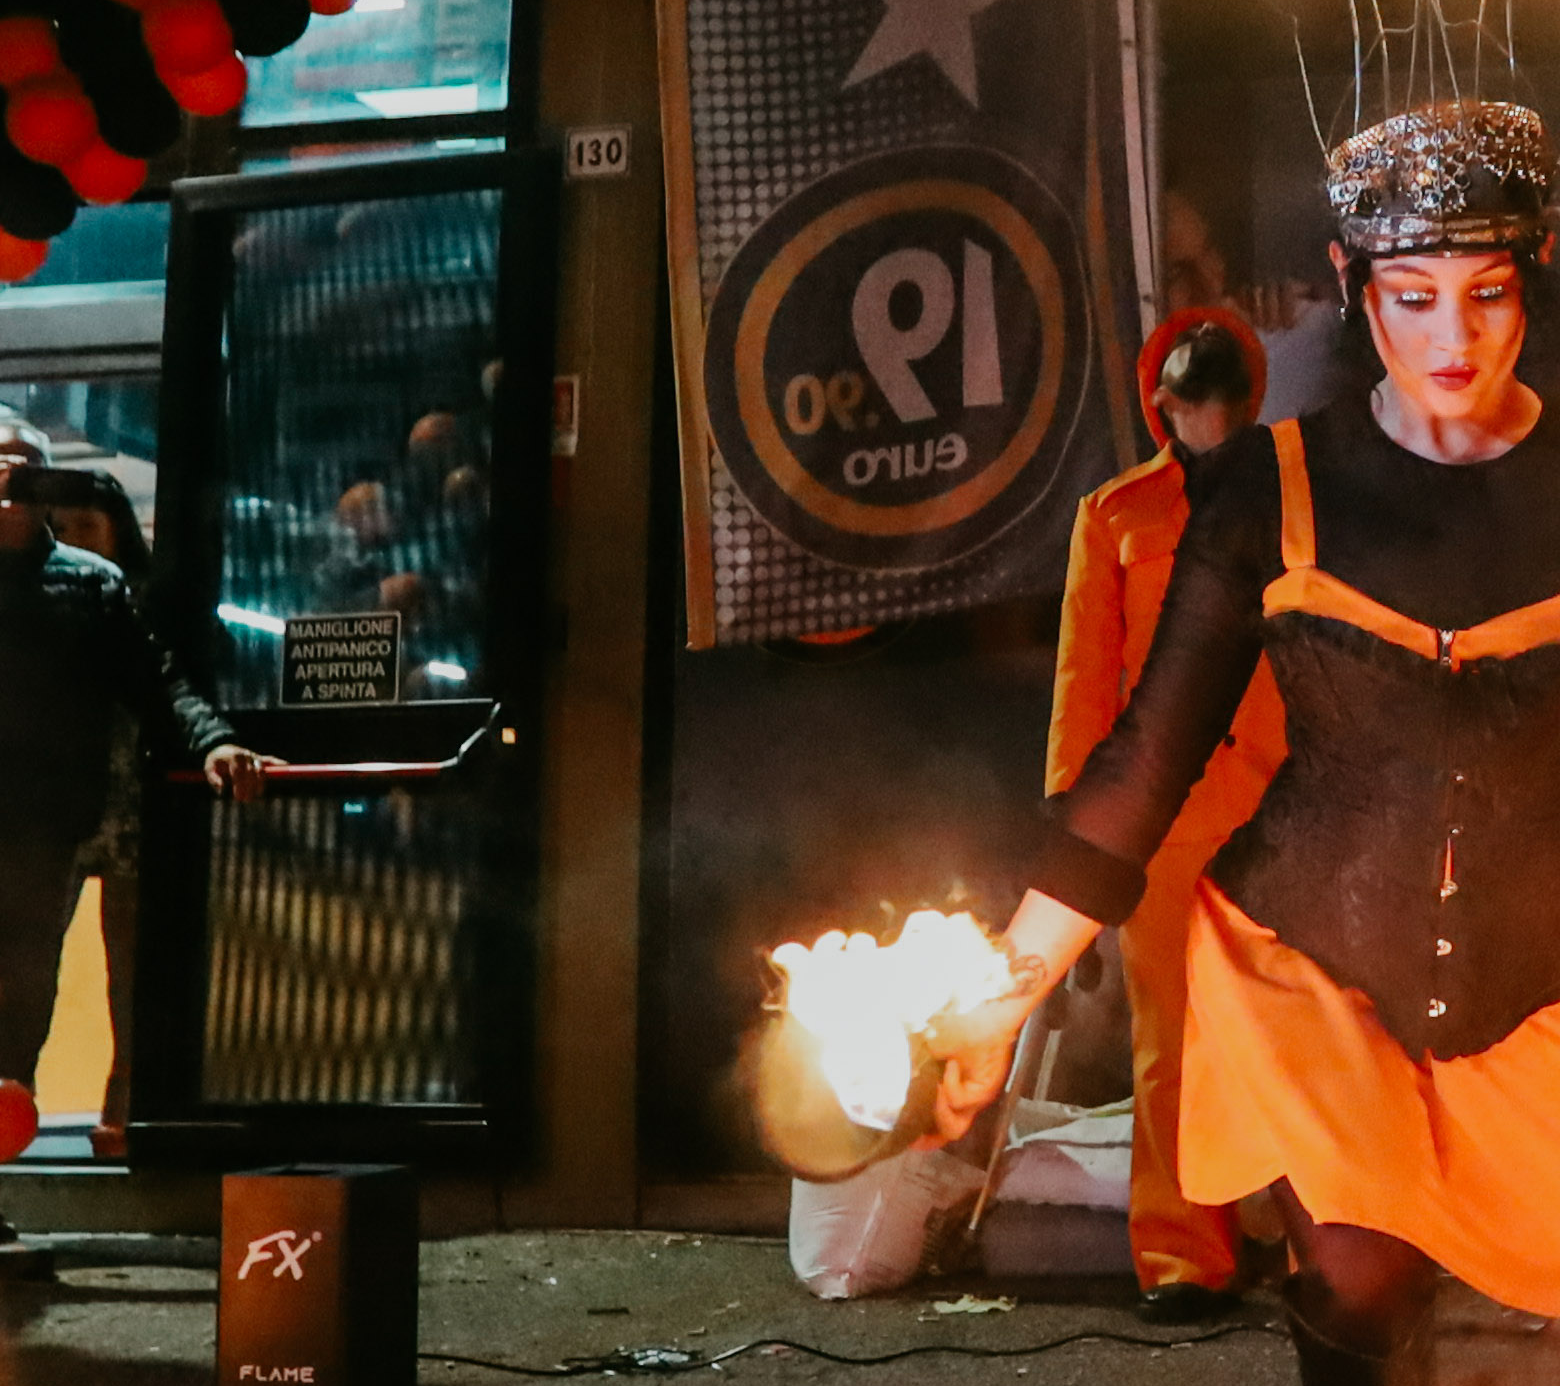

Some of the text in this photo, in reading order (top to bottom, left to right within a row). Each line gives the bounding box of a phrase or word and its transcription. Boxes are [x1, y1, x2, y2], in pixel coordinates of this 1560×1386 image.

[577, 138, 622, 167] 130
[290, 618, 394, 639] MANIGLIONE
[290, 639, 392, 660] ANTIPANICO
[295, 660, 386, 682] APERTURA
[301, 681, 377, 701] A SPINTA
[239, 1365, 315, 1383] FLAME
